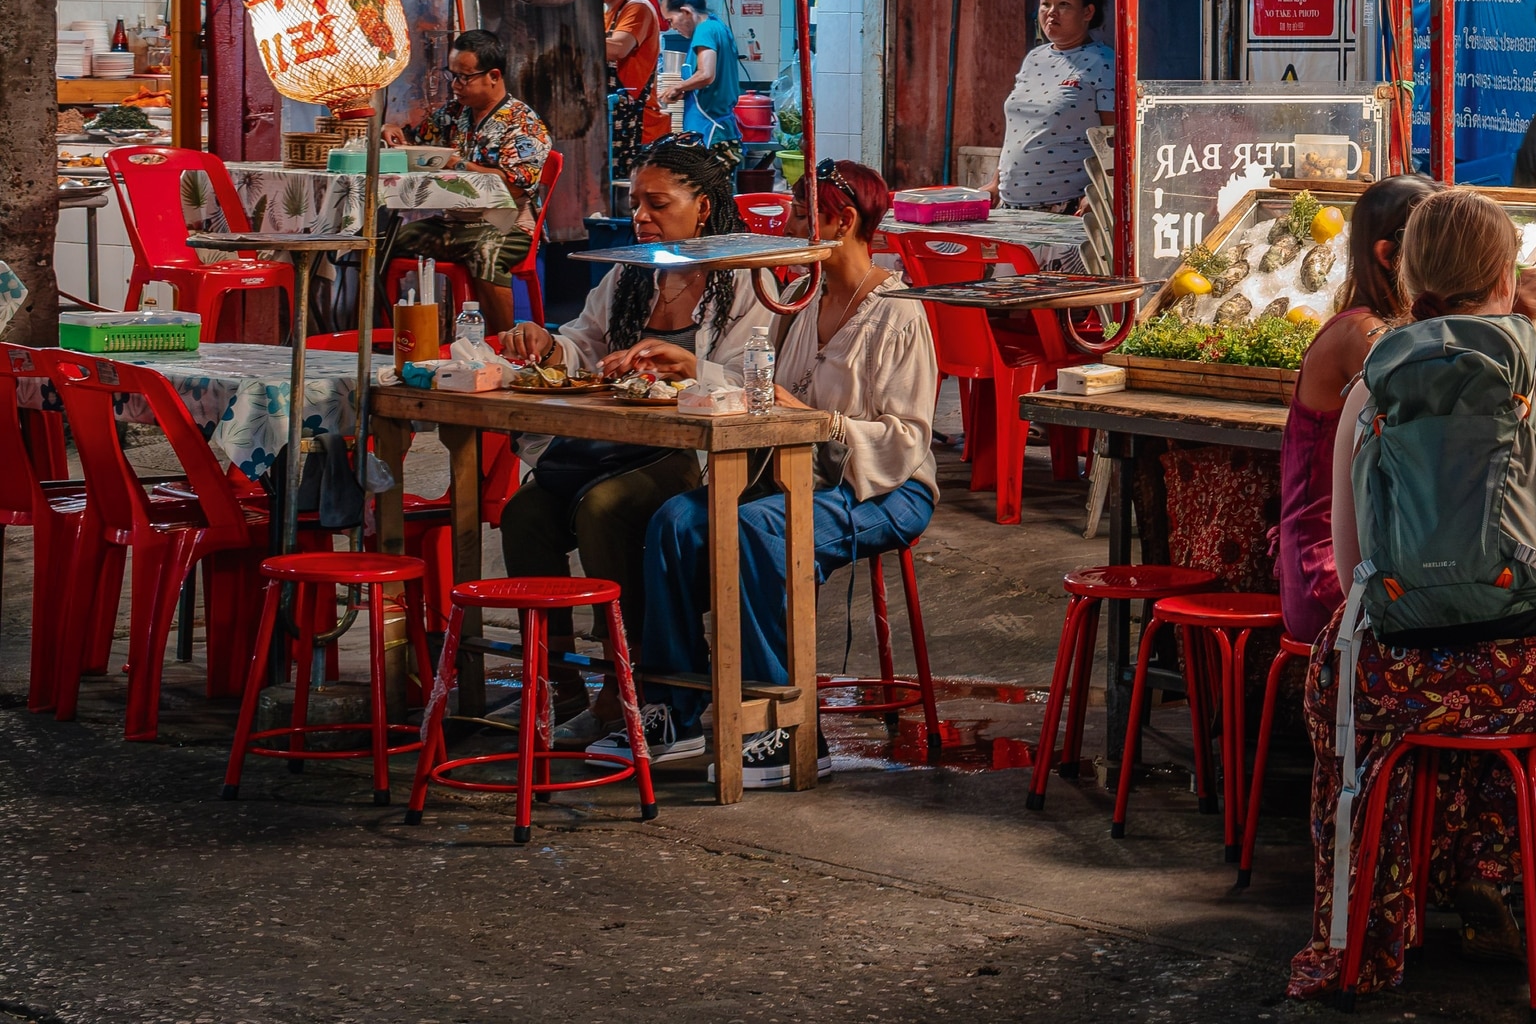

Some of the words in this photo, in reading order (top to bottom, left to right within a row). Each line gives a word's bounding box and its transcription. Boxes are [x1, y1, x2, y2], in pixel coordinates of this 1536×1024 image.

[1265, 9, 1275, 18] NO
[1275, 9, 1292, 18] TAKE
[1292, 9, 1298, 18] A
[1299, 9, 1320, 18] PHOTO
